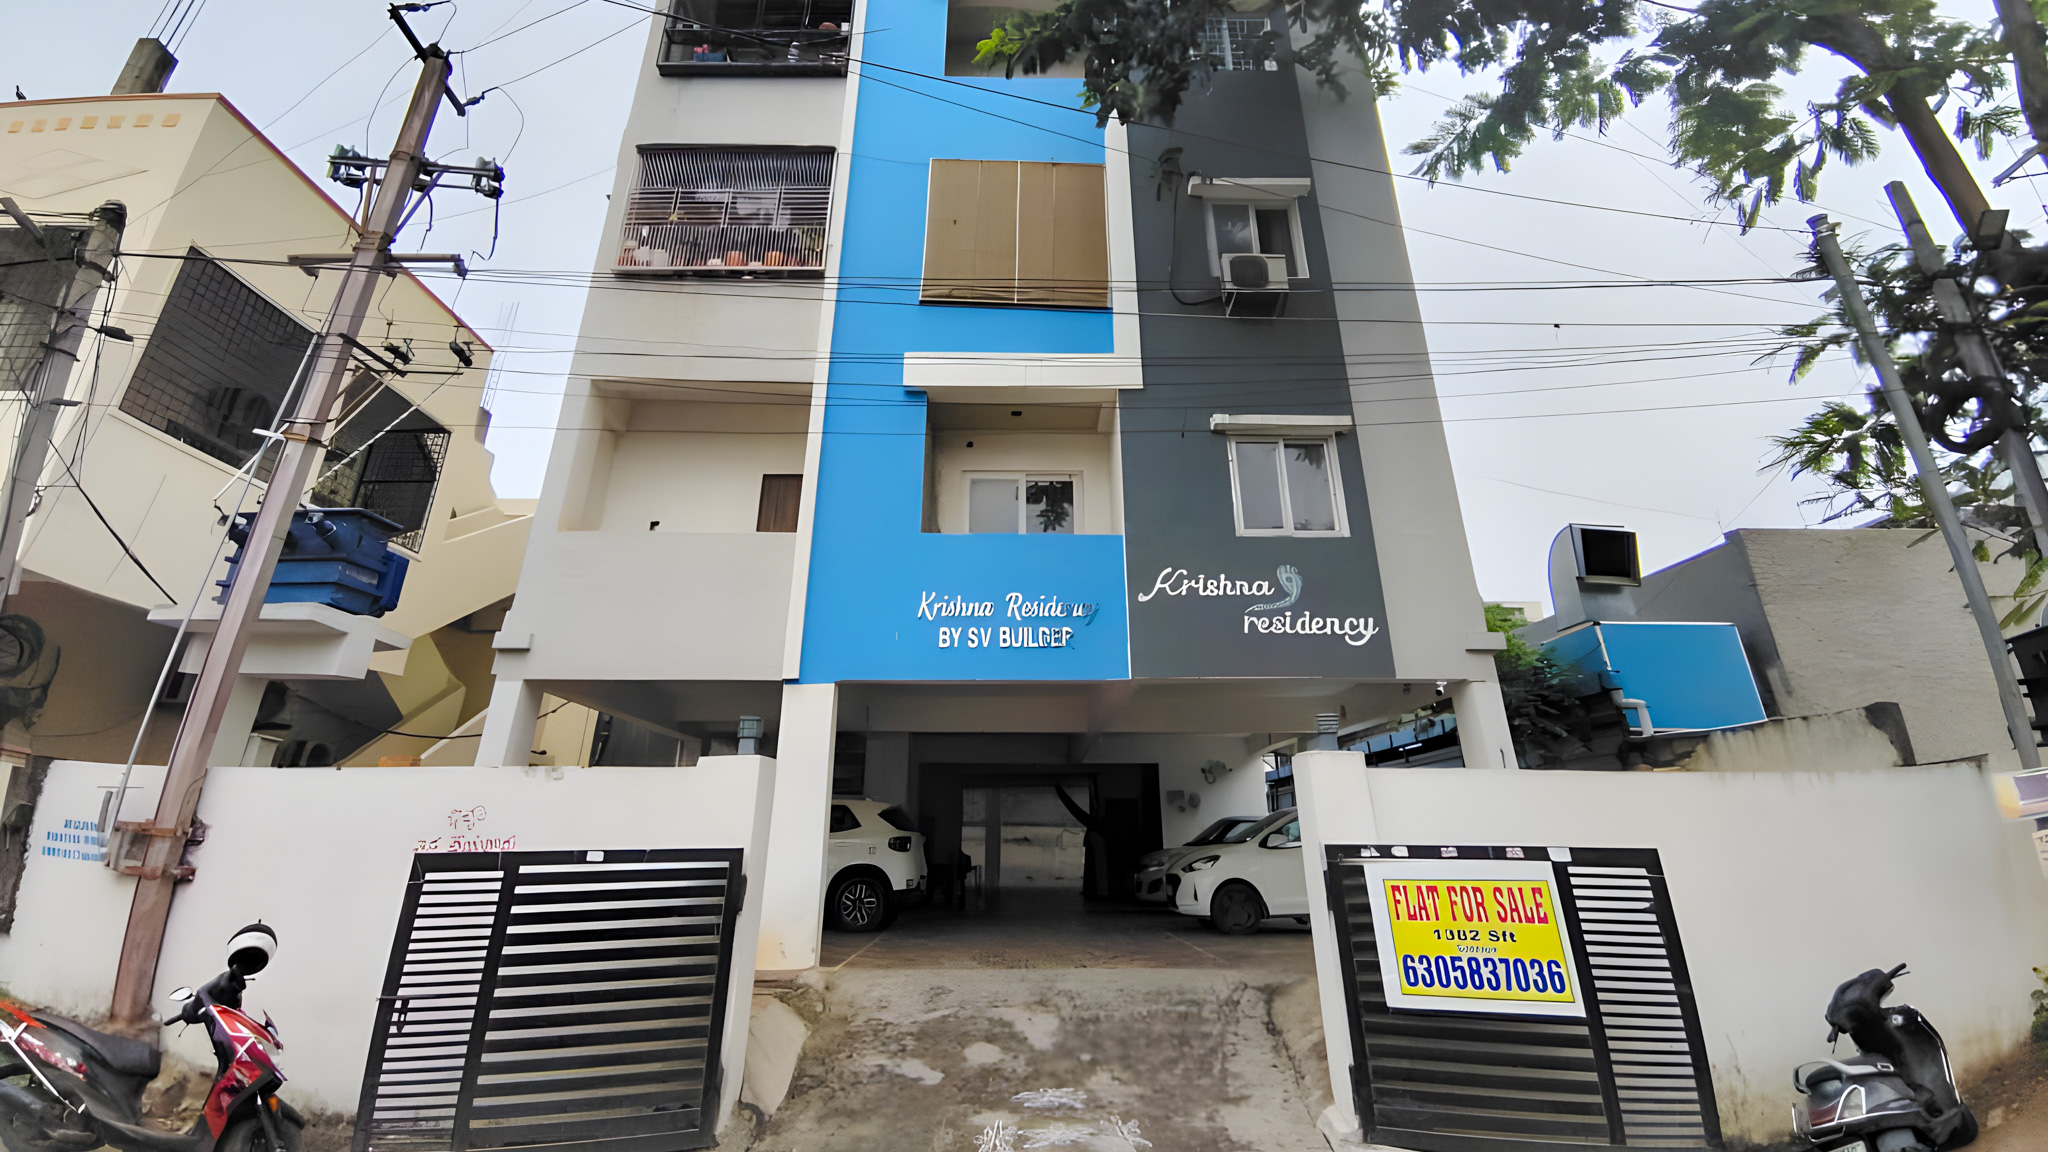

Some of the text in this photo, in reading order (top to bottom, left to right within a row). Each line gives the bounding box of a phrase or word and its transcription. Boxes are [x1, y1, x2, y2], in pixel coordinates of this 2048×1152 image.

[1138, 567, 1275, 602] Krishna
[917, 590, 995, 621] Krishna
[938, 626, 962, 648] BY
[967, 626, 992, 648] SV
[1244, 611, 1379, 646] residency
[1390, 884, 1549, 924] FLAT FOR SALE
[1402, 954, 1566, 994] 6305837036
